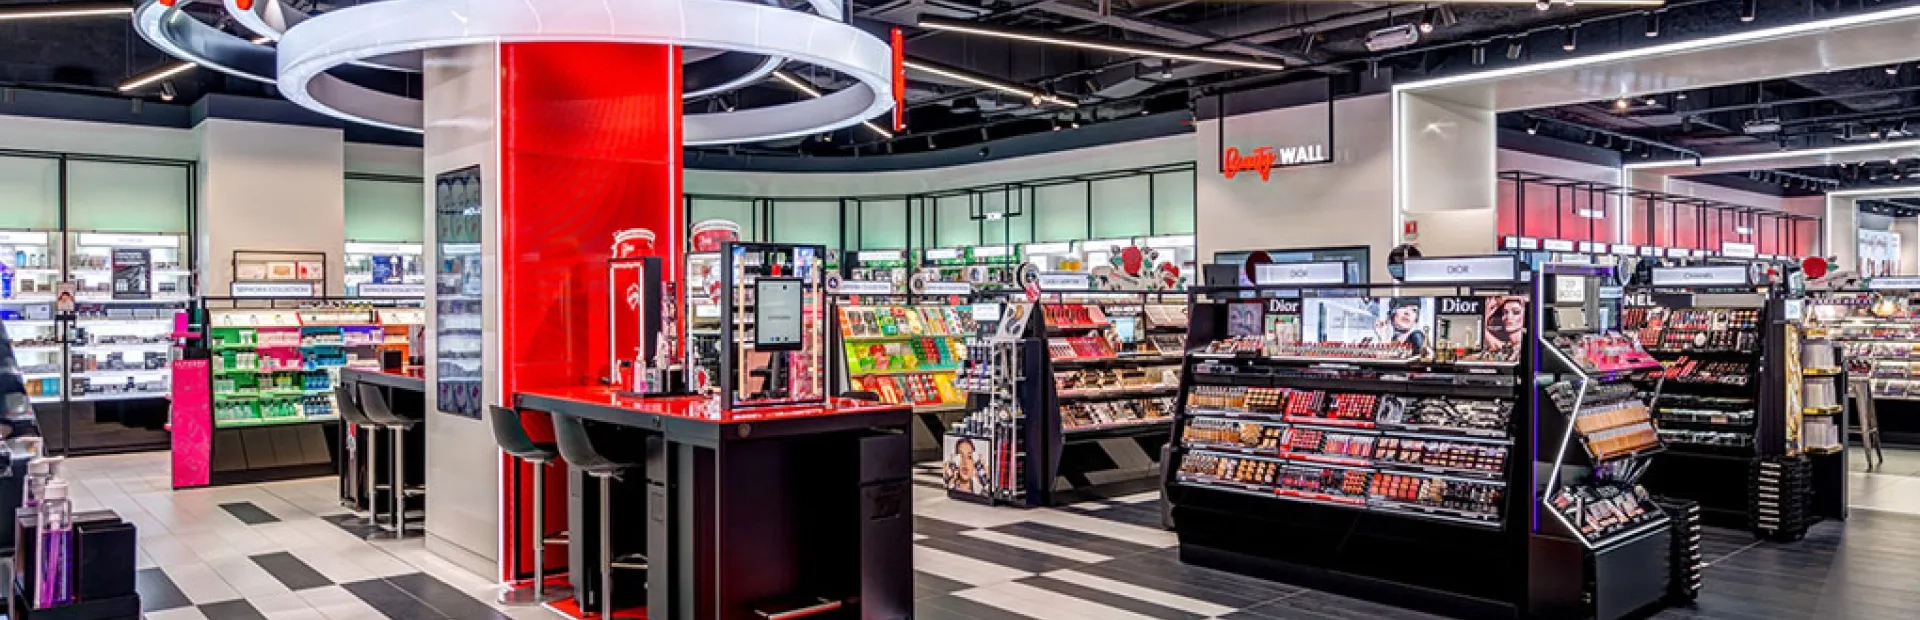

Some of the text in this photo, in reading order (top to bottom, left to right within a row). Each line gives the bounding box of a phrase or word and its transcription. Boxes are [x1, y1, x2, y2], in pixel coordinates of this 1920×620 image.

[1224, 144, 1324, 182] Beauty WALL
[1447, 264, 1469, 275] DIOR
[1270, 299, 1298, 312] Dior
[1442, 298, 1478, 314] Dior
